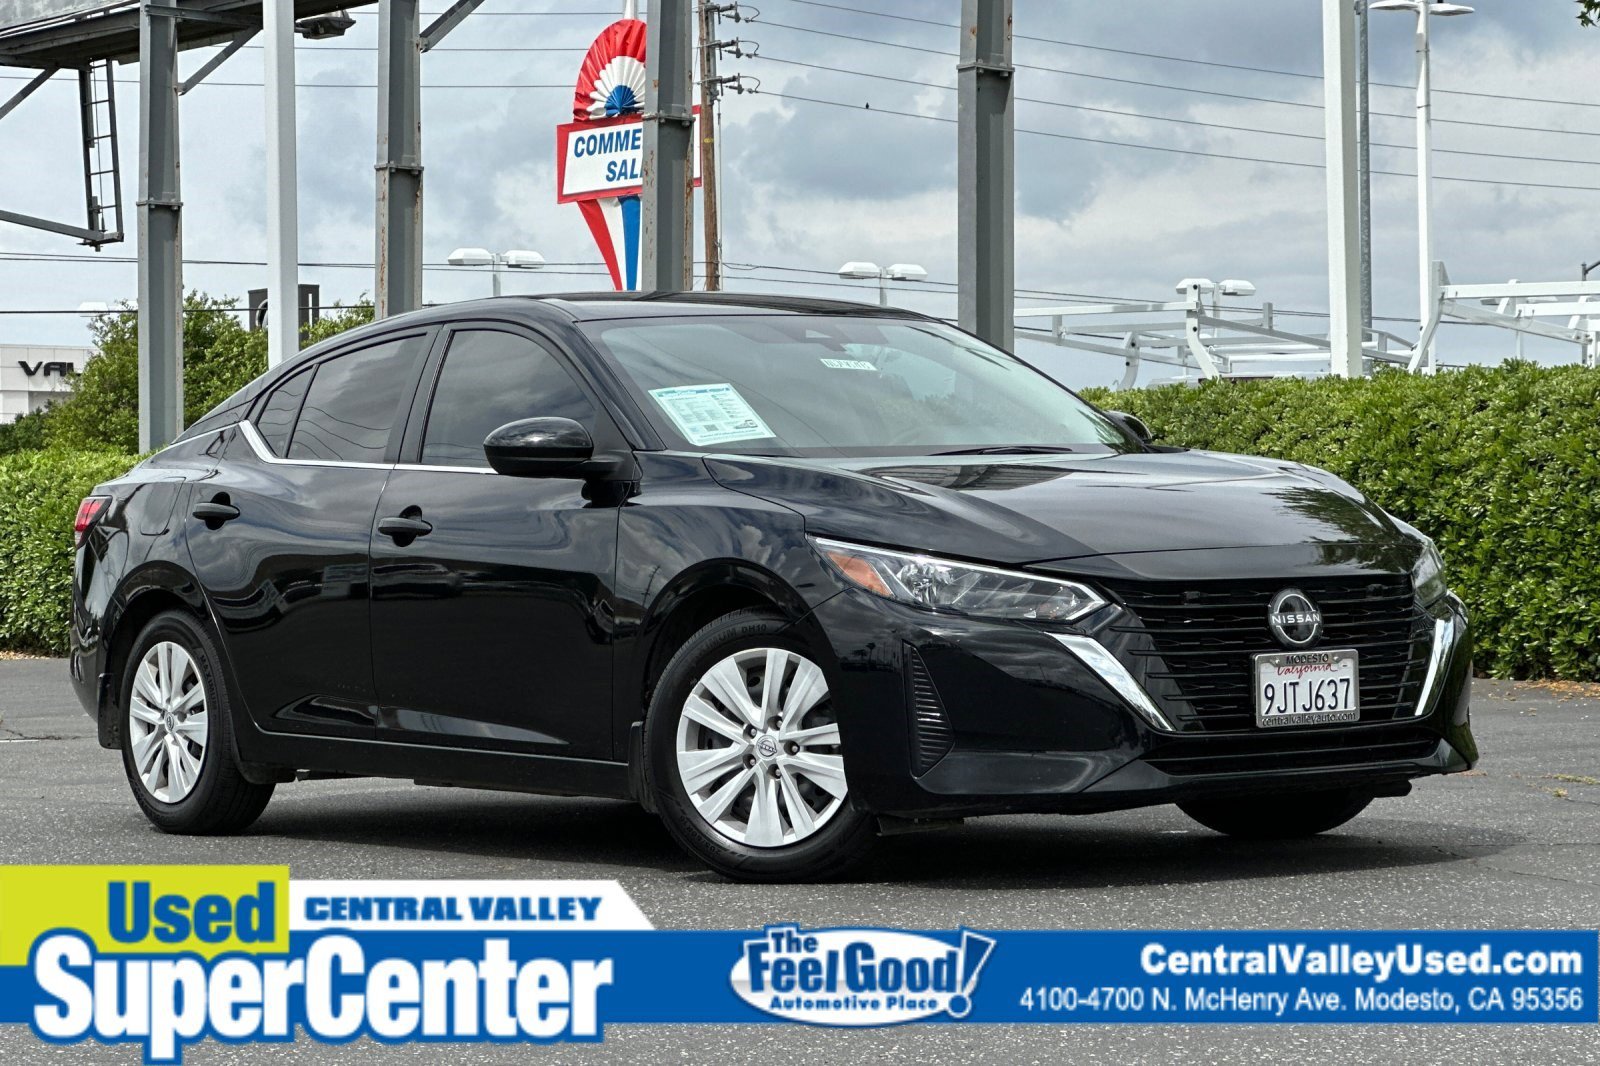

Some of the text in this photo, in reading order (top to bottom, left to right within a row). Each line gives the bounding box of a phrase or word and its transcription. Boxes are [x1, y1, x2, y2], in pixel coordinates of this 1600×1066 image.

[605, 158, 642, 182] SAL
[1272, 613, 1321, 624] NISSAN
[1286, 653, 1329, 664] MODESTO
[1264, 678, 1351, 715] 9JTJ637
[1262, 712, 1356, 727] centralvalleyauto.com
